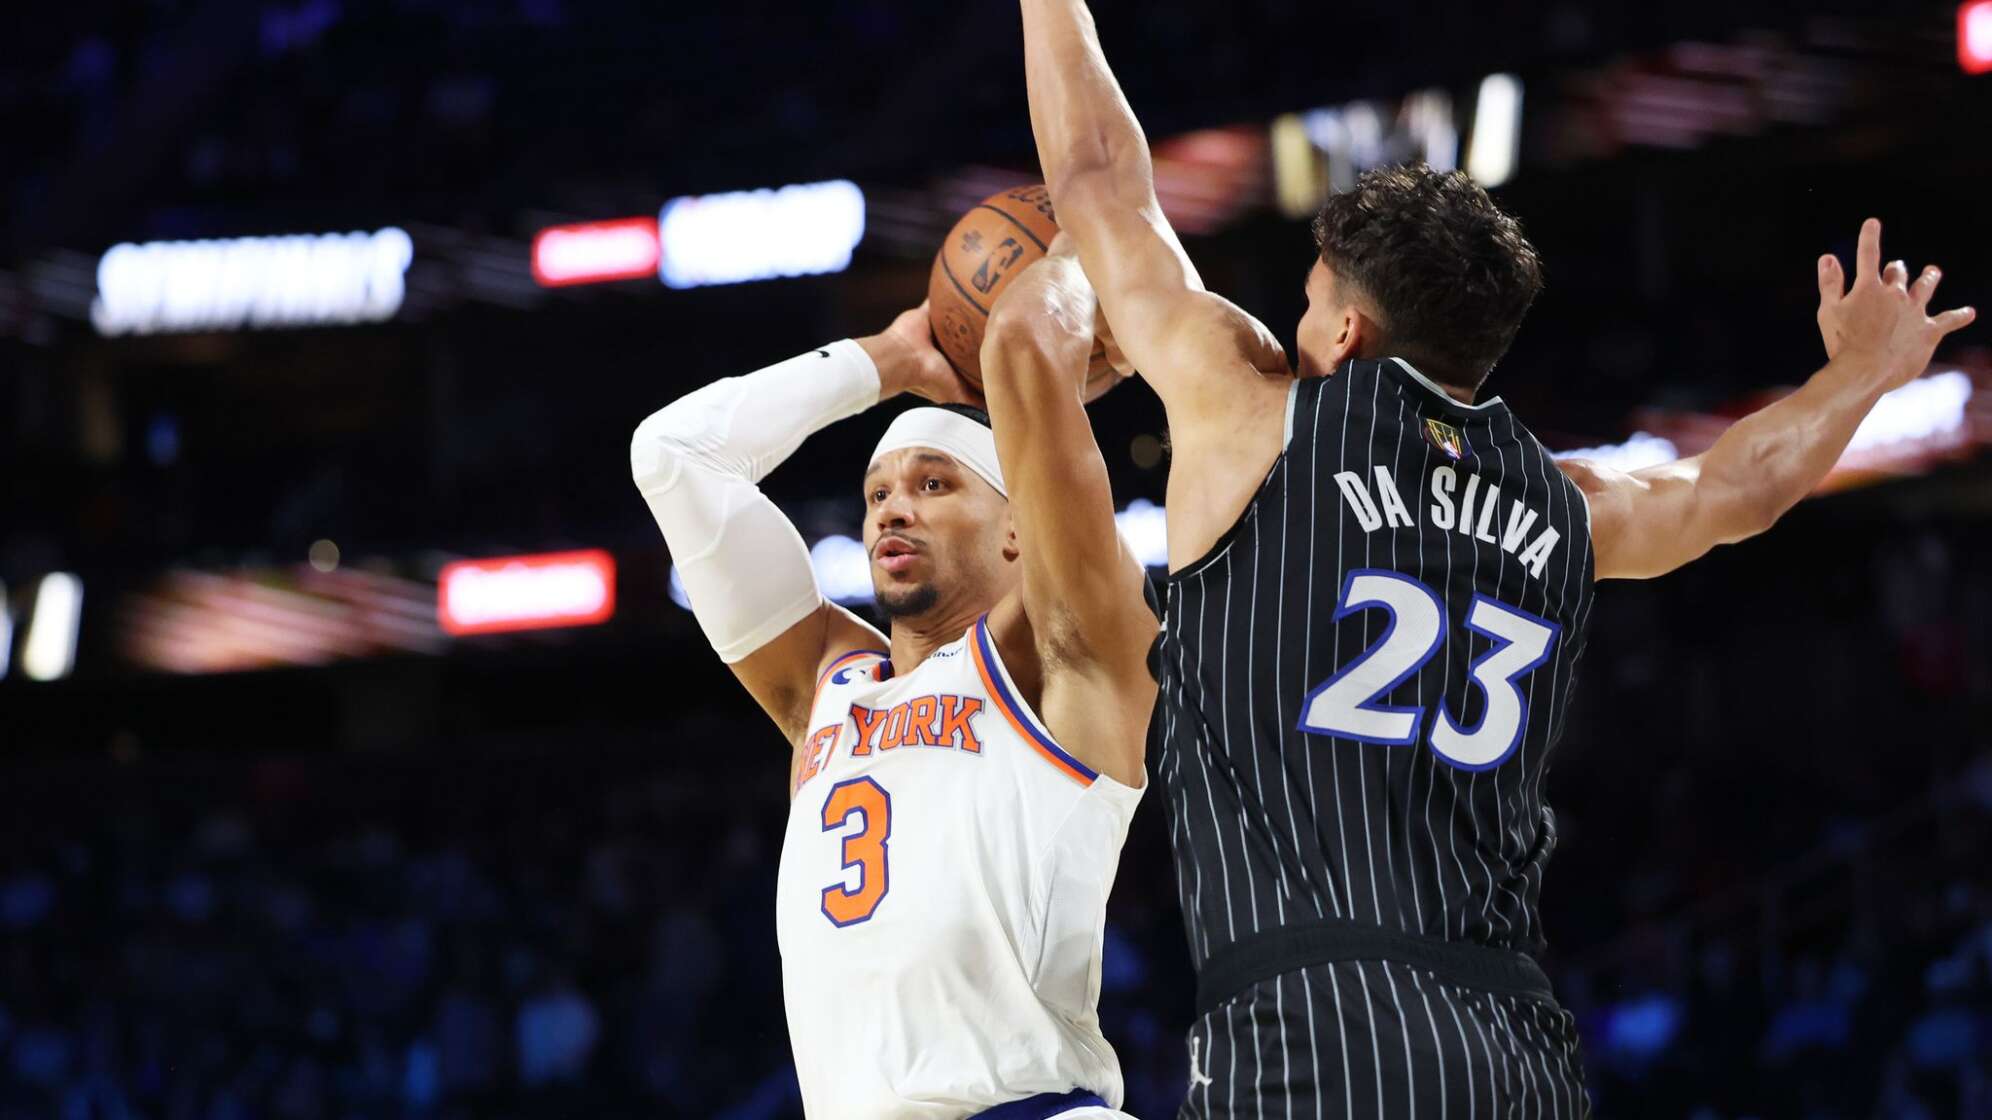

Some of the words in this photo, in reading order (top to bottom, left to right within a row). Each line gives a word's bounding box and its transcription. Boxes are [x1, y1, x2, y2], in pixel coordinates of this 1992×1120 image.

[1333, 465, 1415, 533] DA
[1430, 465, 1561, 580] SILVA
[848, 694, 986, 756] YORK
[1296, 568, 1562, 772] 23
[821, 775, 891, 928] 3
